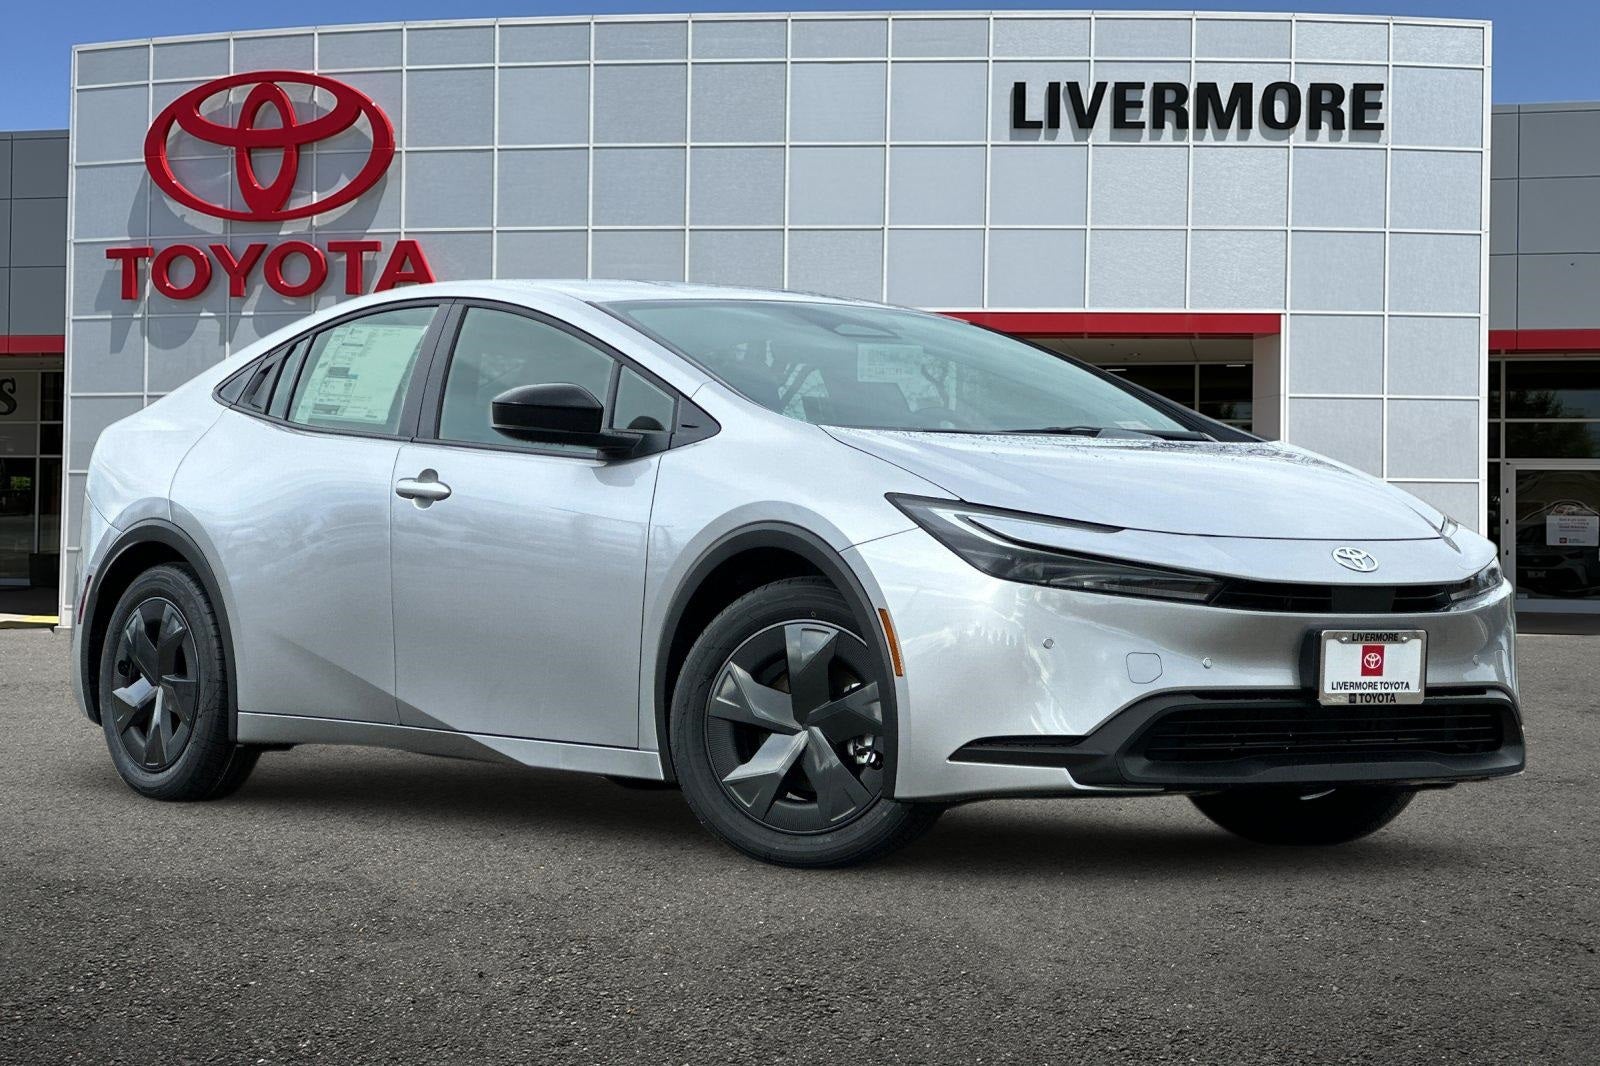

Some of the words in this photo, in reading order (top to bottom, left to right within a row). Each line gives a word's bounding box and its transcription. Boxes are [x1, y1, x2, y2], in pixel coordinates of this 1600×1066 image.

[1012, 81, 1385, 131] LIVERMORE
[106, 239, 436, 300] TOYOTA
[1352, 632, 1399, 642] LIVERMORE
[1331, 681, 1379, 691] LIVERMORE
[1379, 681, 1410, 690] TOYOTA
[1359, 693, 1397, 704] TOYOTA
